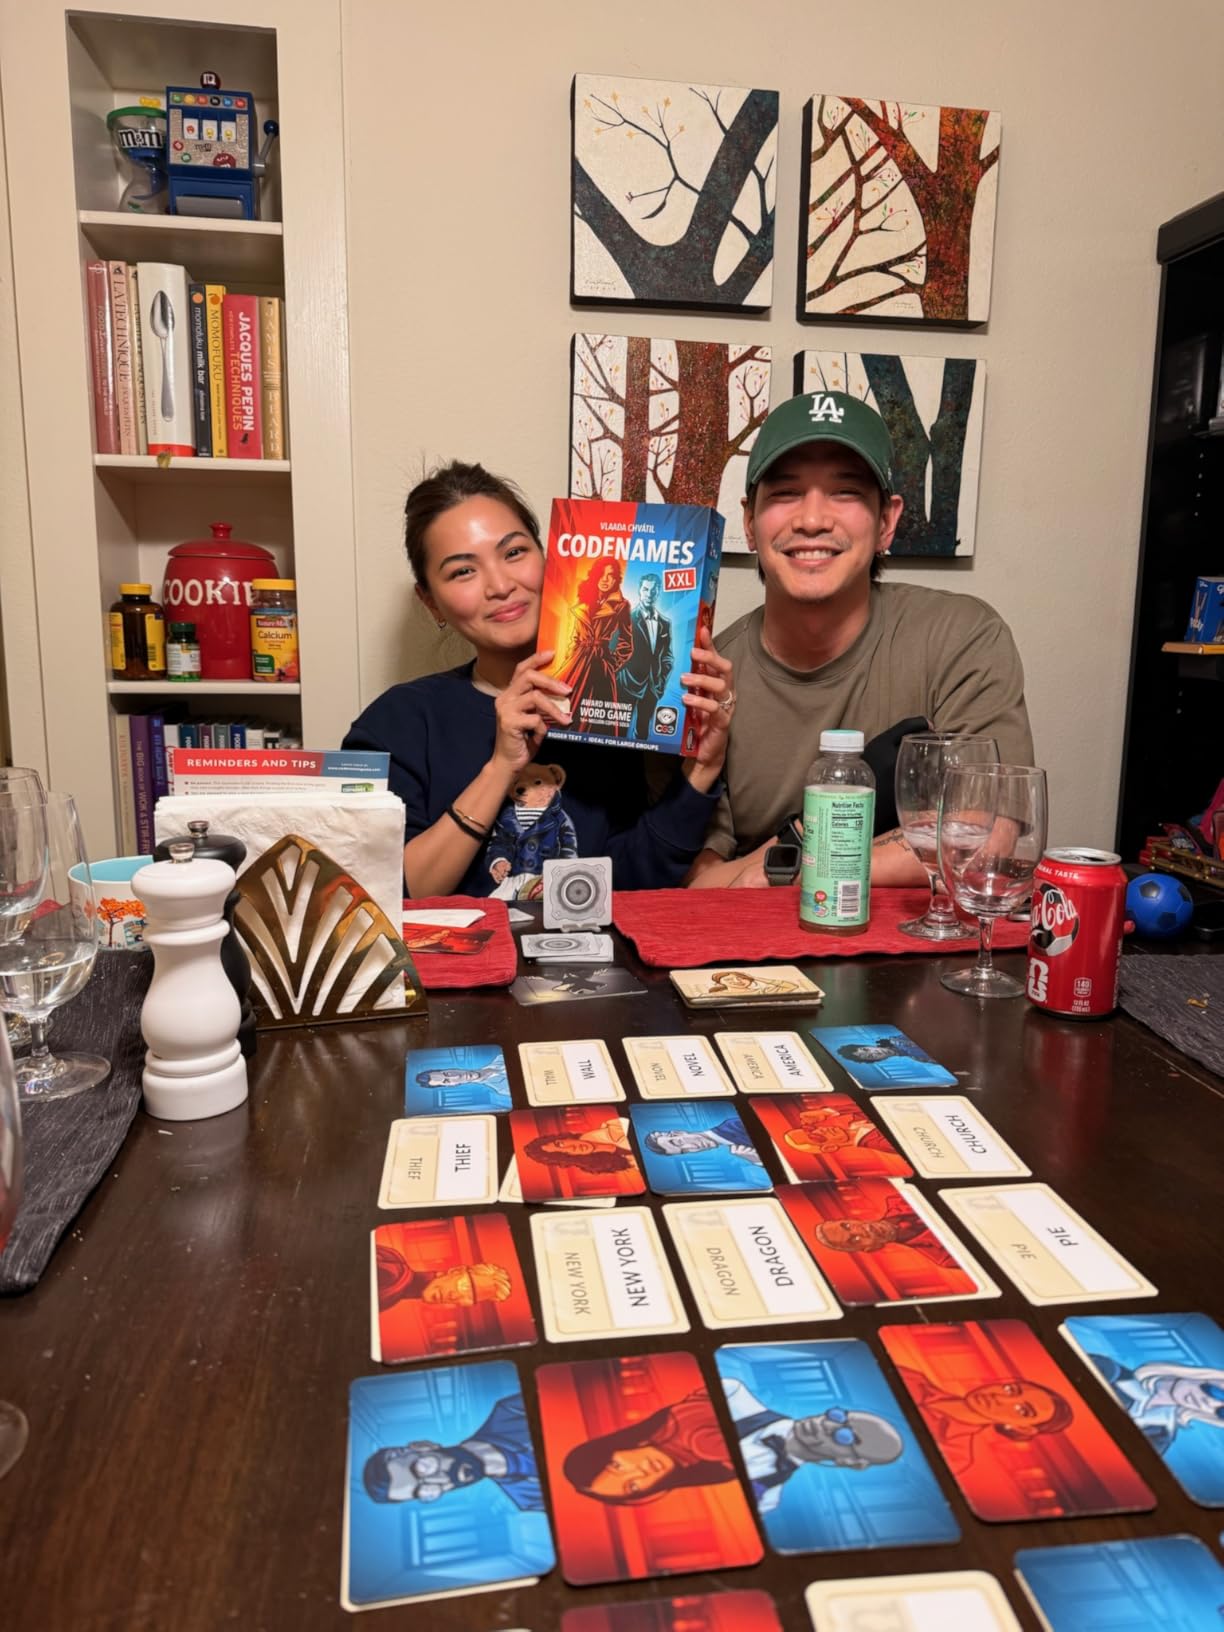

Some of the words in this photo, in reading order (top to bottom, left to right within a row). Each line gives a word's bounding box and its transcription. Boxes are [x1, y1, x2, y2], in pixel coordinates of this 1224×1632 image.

[211, 310, 222, 381] MOMOFUKU
[239, 312, 252, 382] JACQUES
[196, 350, 204, 368] milk
[197, 369, 206, 385] bar
[230, 351, 242, 430] TECHNIQUES
[242, 386, 254, 431] PEPIN
[808, 393, 844, 423] LA
[600, 521, 627, 531] VLAADA
[628, 522, 656, 534] CHVÁTIL
[557, 533, 695, 565] CODENAMES
[667, 571, 693, 587] XXL
[258, 630, 292, 640] Calcium
[580, 707, 605, 718] WORD
[607, 710, 632, 722] GAME
[581, 698, 603, 708] AWARD
[604, 700, 633, 711] WINNING
[588, 736, 604, 744] IDEAL
[136, 752, 144, 766] BIG
[187, 758, 258, 768] REMINDERS
[261, 759, 288, 768] AND
[291, 760, 316, 769] TIPS
[138, 791, 147, 811] WOK
[583, 1059, 597, 1080] WALL
[683, 1052, 705, 1077] NOVEL
[774, 1044, 802, 1077] AMERICA
[912, 1126, 946, 1159] CHURCH
[944, 1115, 987, 1155] CHURCH
[407, 1156, 423, 1181] THIEF
[454, 1142, 472, 1173] THIEF
[615, 1227, 639, 1266] YORK
[1047, 1227, 1079, 1247] PIE
[748, 1225, 795, 1287] DRAGON
[1010, 1243, 1037, 1260] PIE
[564, 1252, 582, 1278] NEW
[706, 1247, 740, 1297] DRAGON
[571, 1279, 592, 1315] YORK
[624, 1268, 649, 1307] NEW
